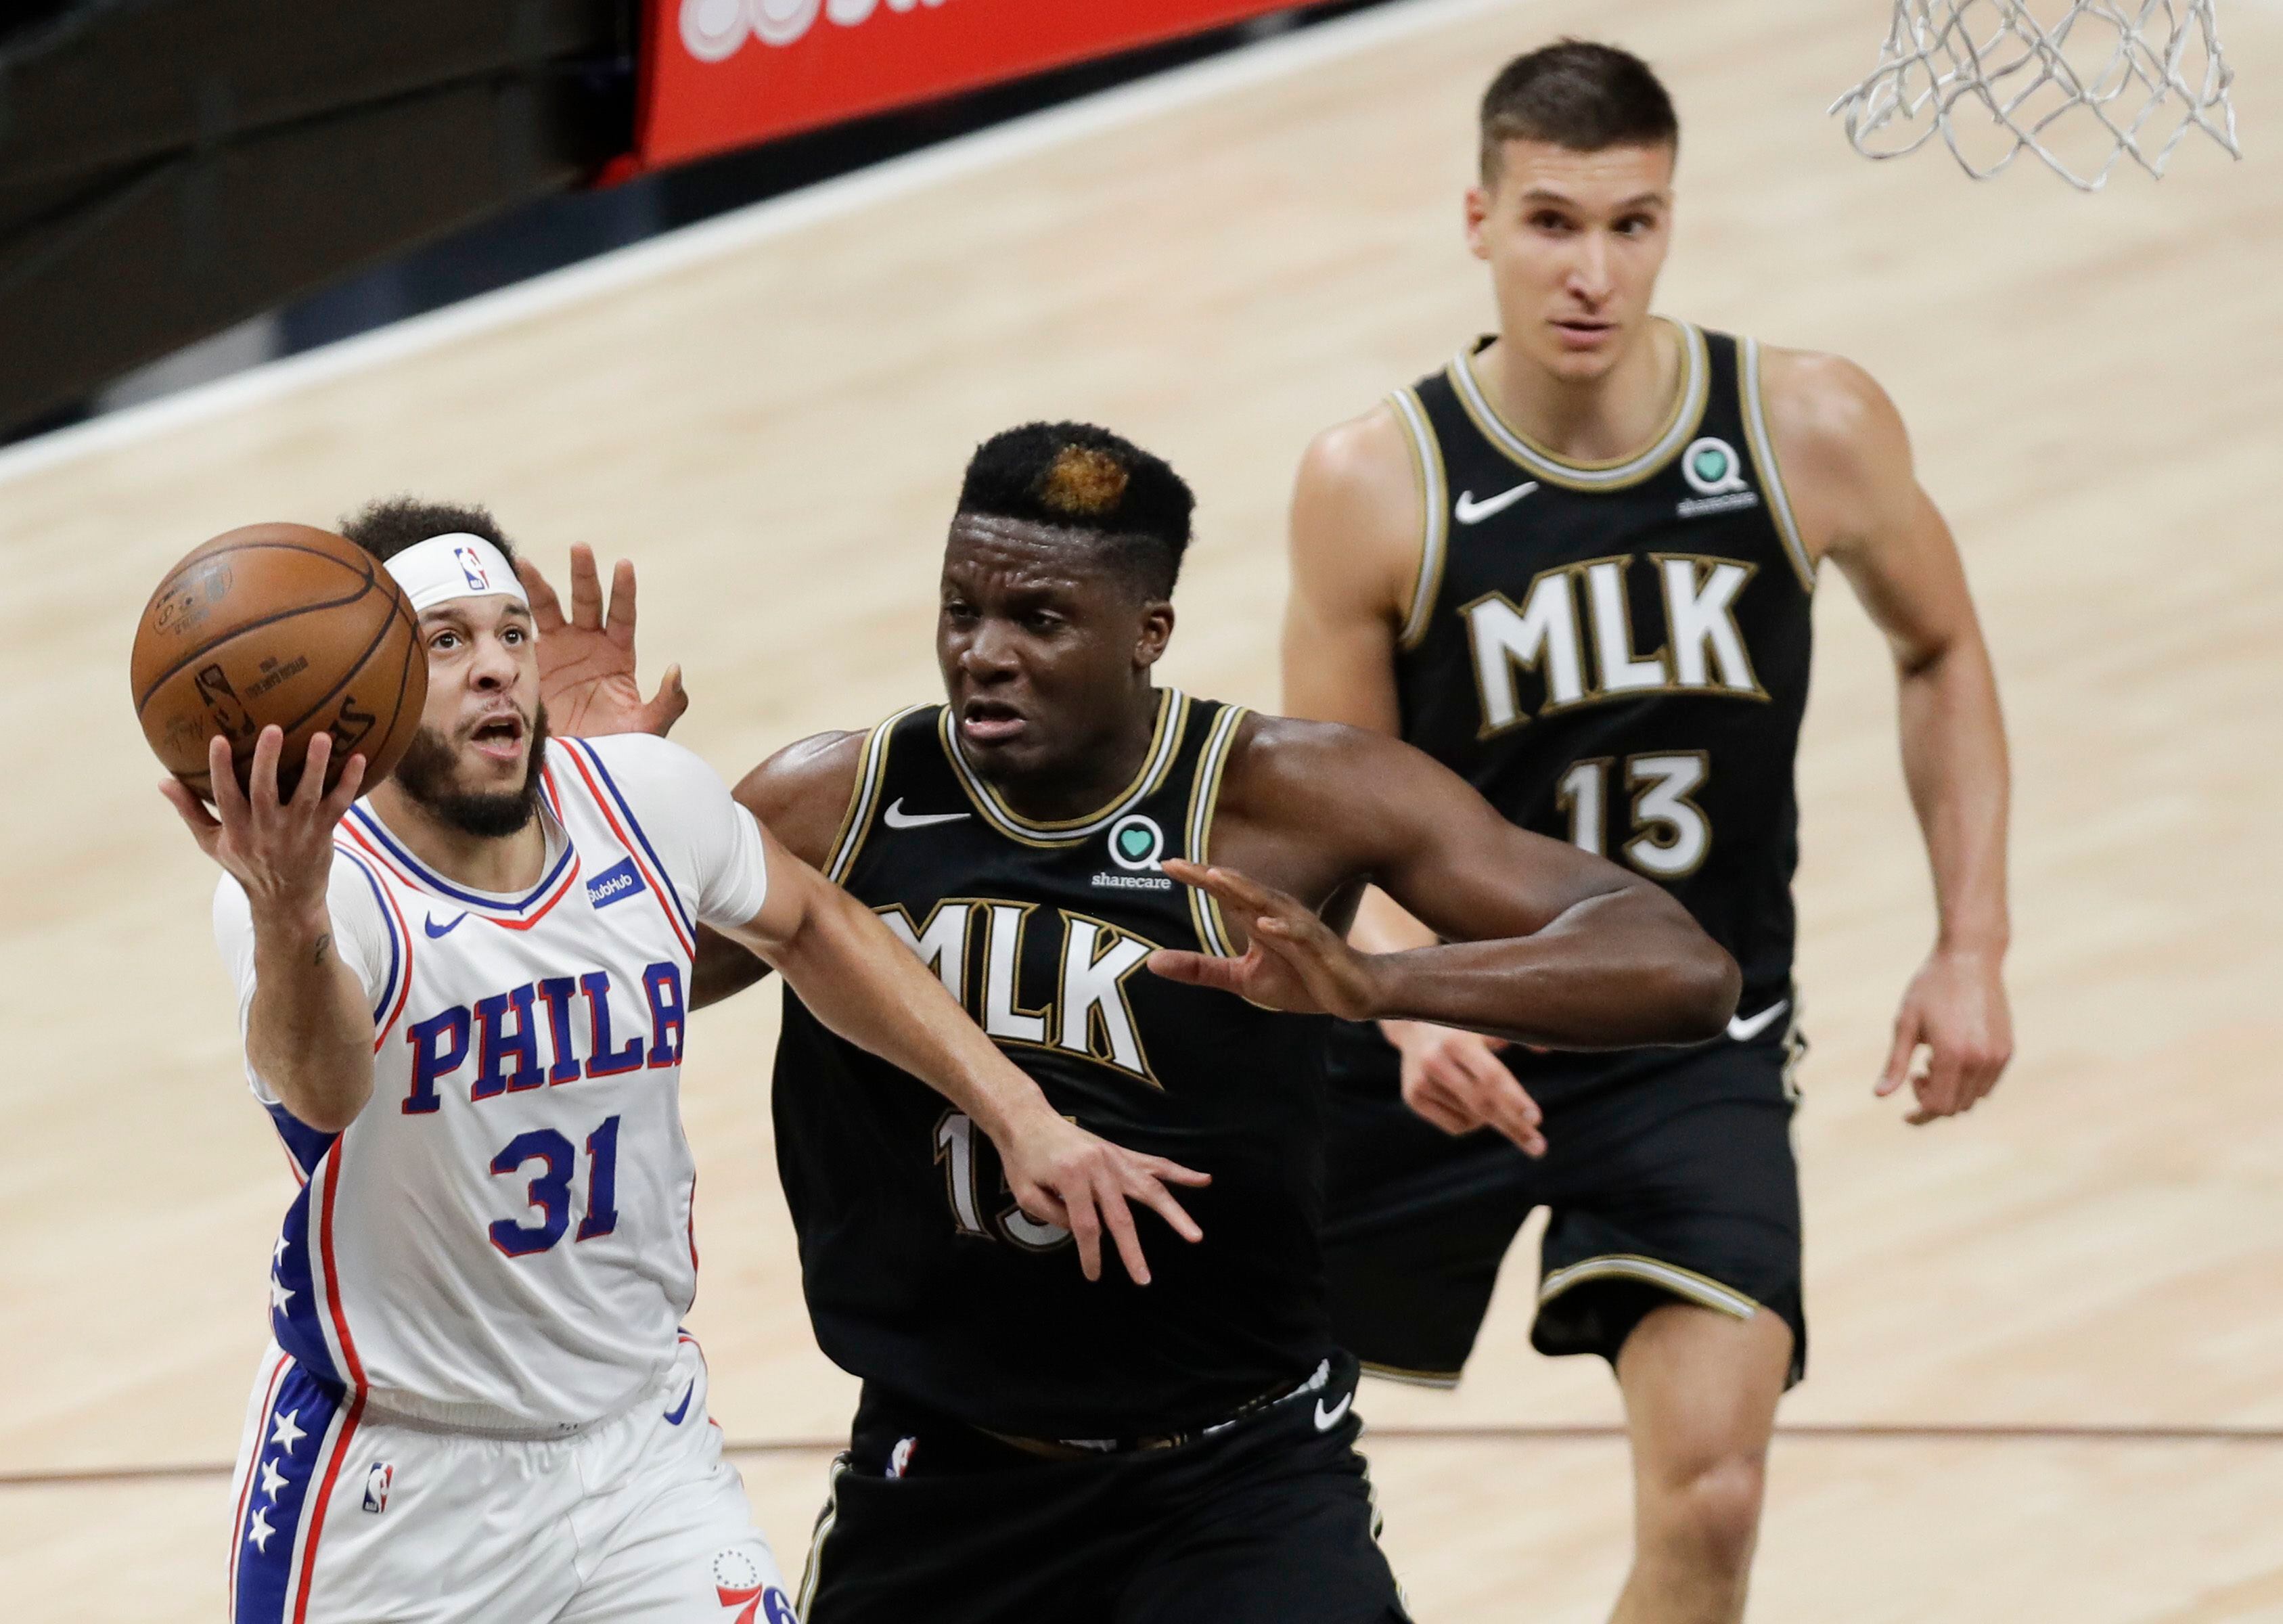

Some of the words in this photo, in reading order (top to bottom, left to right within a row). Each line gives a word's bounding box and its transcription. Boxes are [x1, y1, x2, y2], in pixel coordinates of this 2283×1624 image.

[1457, 551, 1772, 741] MLK
[1091, 872, 1172, 890] sharecare
[1556, 750, 1713, 879] 13
[402, 961, 684, 1114] PHILA
[489, 1115, 620, 1258] 31
